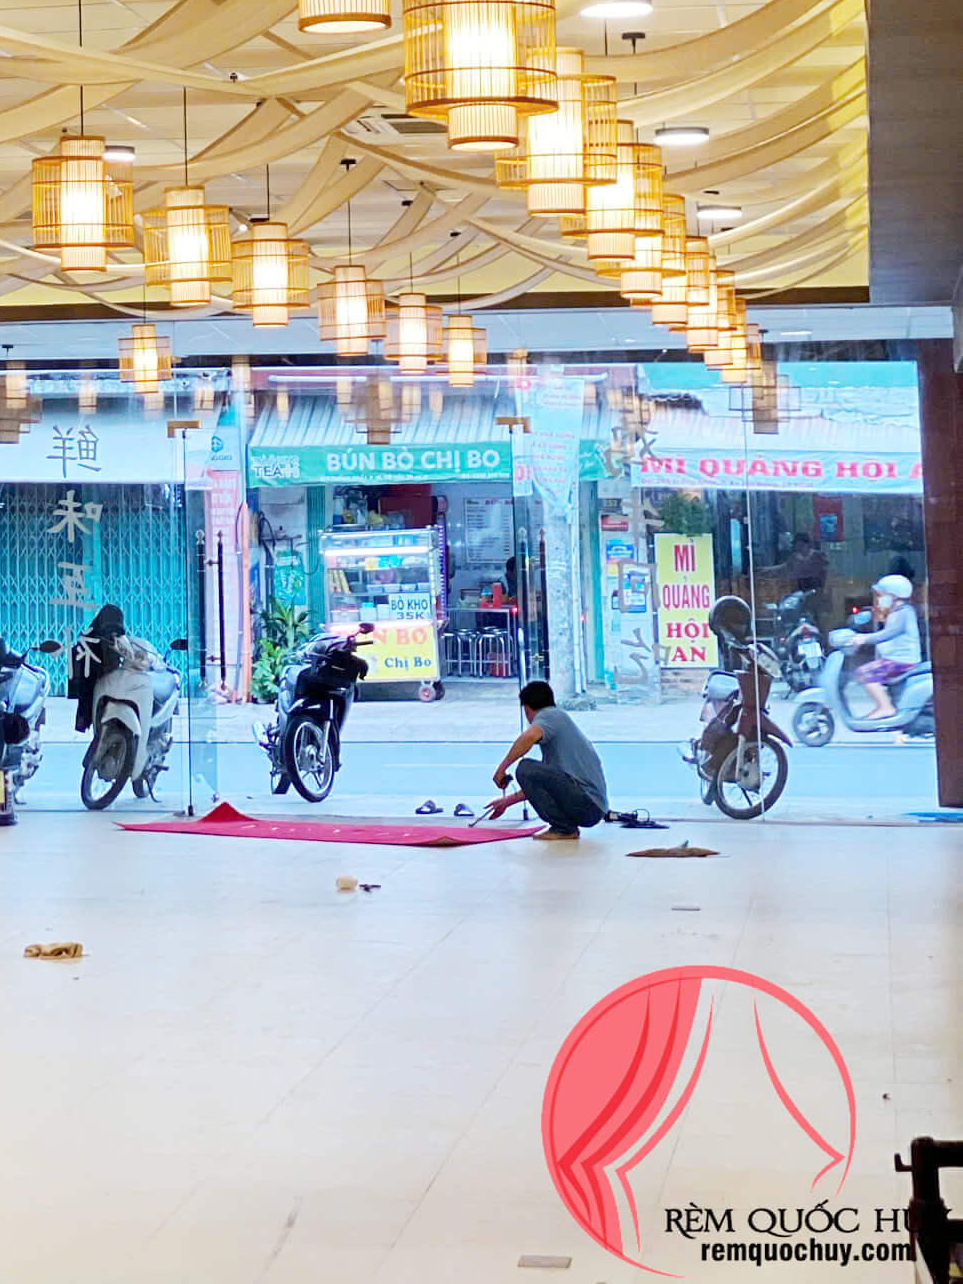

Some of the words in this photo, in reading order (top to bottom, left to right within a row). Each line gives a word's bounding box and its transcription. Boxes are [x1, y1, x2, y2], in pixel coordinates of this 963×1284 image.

[327, 448, 376, 472] BÚN
[382, 446, 414, 470] BÒ
[421, 450, 460, 473] CHỊ
[468, 449, 500, 468] BO
[699, 454, 823, 478] QUẢNG
[836, 458, 897, 482] HỘI
[673, 539, 696, 572] MÌ
[407, 599, 428, 611] KHO
[662, 576, 710, 611] QUẢNG
[666, 618, 710, 643] HỘI
[413, 656, 431, 668] Bo
[671, 646, 707, 662] AN
